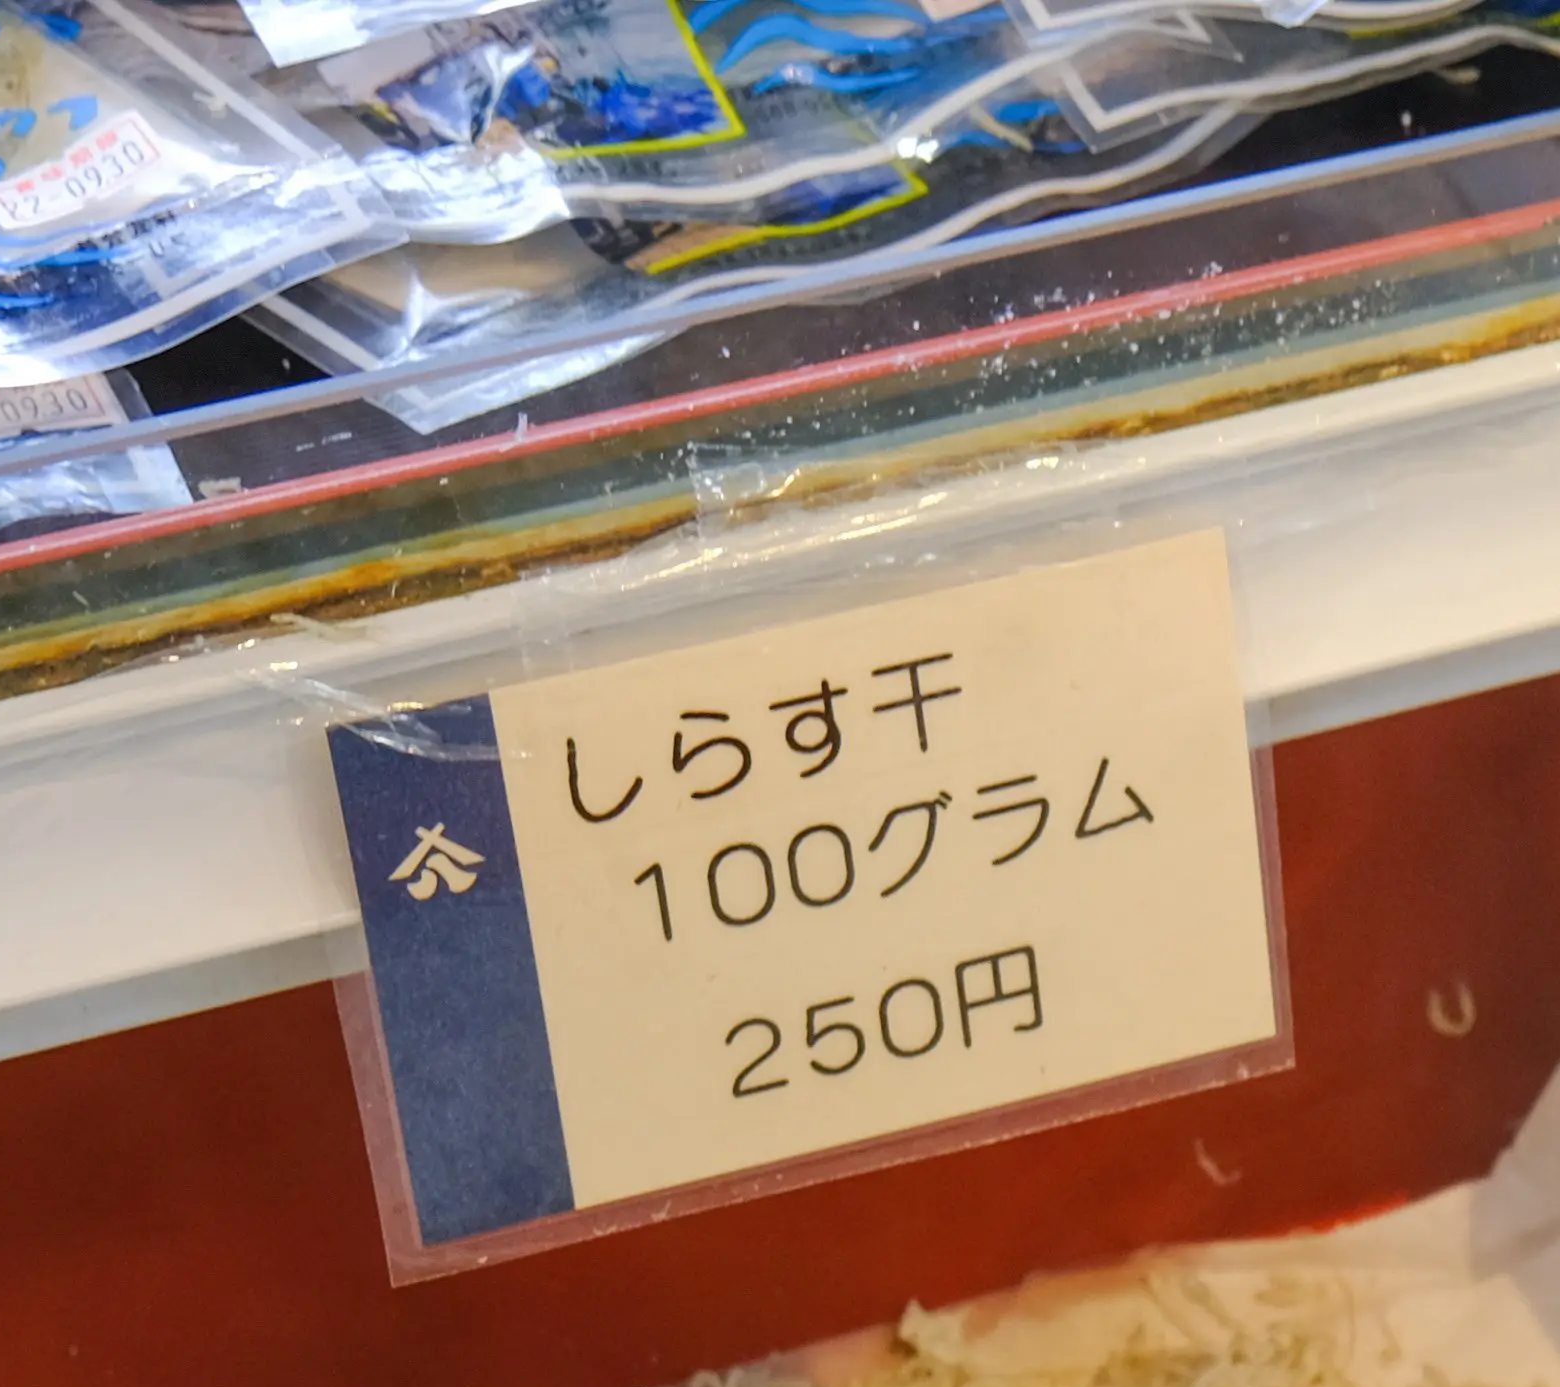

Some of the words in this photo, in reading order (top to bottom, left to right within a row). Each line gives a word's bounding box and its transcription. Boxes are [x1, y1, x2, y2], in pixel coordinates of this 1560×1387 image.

[565, 650, 964, 825] しらす干
[633, 755, 1155, 942] 100グラム
[723, 944, 1044, 1098] 250円
